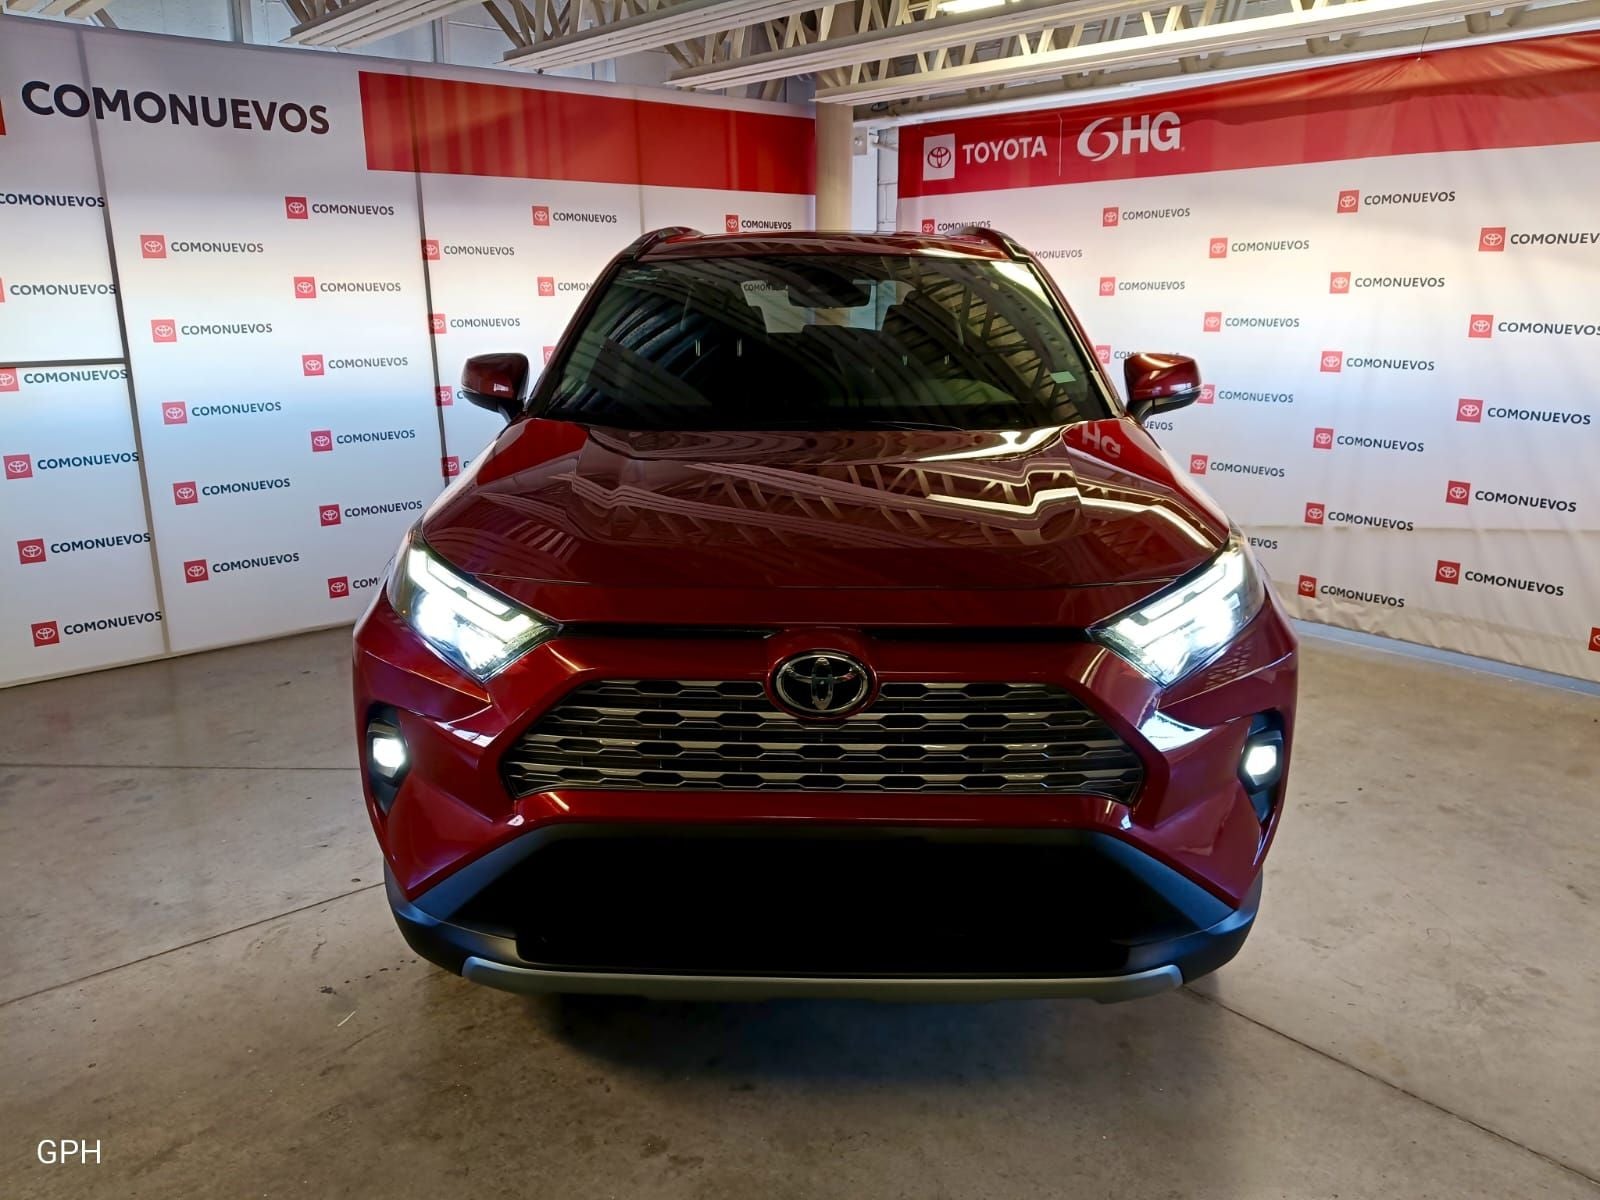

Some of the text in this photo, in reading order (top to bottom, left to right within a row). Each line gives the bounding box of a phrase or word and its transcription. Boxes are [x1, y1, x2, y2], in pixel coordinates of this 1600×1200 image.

[22, 81, 329, 134] COMONUEVOS
[1122, 111, 1181, 155] HG
[963, 136, 1047, 165] TOYOTA
[1364, 191, 1455, 205] COMONUEVOS
[312, 204, 394, 215] COMONUEVOS
[1122, 208, 1190, 220] COMONUEVOS
[553, 212, 617, 223] COMONUEVOS
[742, 220, 791, 230] COMONUEVOS
[171, 242, 263, 252] COMONUEVOS
[444, 246, 514, 255] COMONUEVOS
[1232, 240, 1309, 252] COMONUEVOS
[1033, 249, 1082, 259] MONUEVOS
[10, 284, 116, 295] COMONUEVOS
[320, 283, 401, 292] COMONUEVOS
[1119, 281, 1185, 290] COMONUEVOS
[1355, 278, 1445, 287] COMONUEVOS
[181, 323, 272, 335] COMONUEVOS
[450, 318, 520, 328] COMONUEVOS
[1225, 318, 1299, 327] COMONUEVOS
[328, 357, 408, 369] COMONUEVOS
[1347, 358, 1434, 371] COMONUEVOS
[24, 369, 127, 384] COMONUEVOS
[1219, 391, 1293, 403] COMONUEVOS
[192, 402, 281, 416] COMONUEVOS
[1488, 408, 1590, 424] COMONUEVOS
[337, 430, 415, 444] COMONUEVOS
[1337, 436, 1424, 452] COMONUEVOS
[38, 452, 139, 470] COMONUEVOS
[1210, 461, 1284, 477] COMONUEVOS
[202, 478, 290, 495] COMONUEVOS
[1475, 491, 1576, 512] COMONUEVOS
[345, 502, 422, 517] COMONUEVOS
[1328, 512, 1413, 531] COMONUEVOS
[51, 533, 150, 553] COMONUEVOS
[213, 553, 299, 573] COMONUEVOS
[1465, 571, 1564, 596] COMONUEVOS
[1320, 586, 1404, 607] COMONUEVOS
[64, 611, 162, 635] COMONUEVOS
